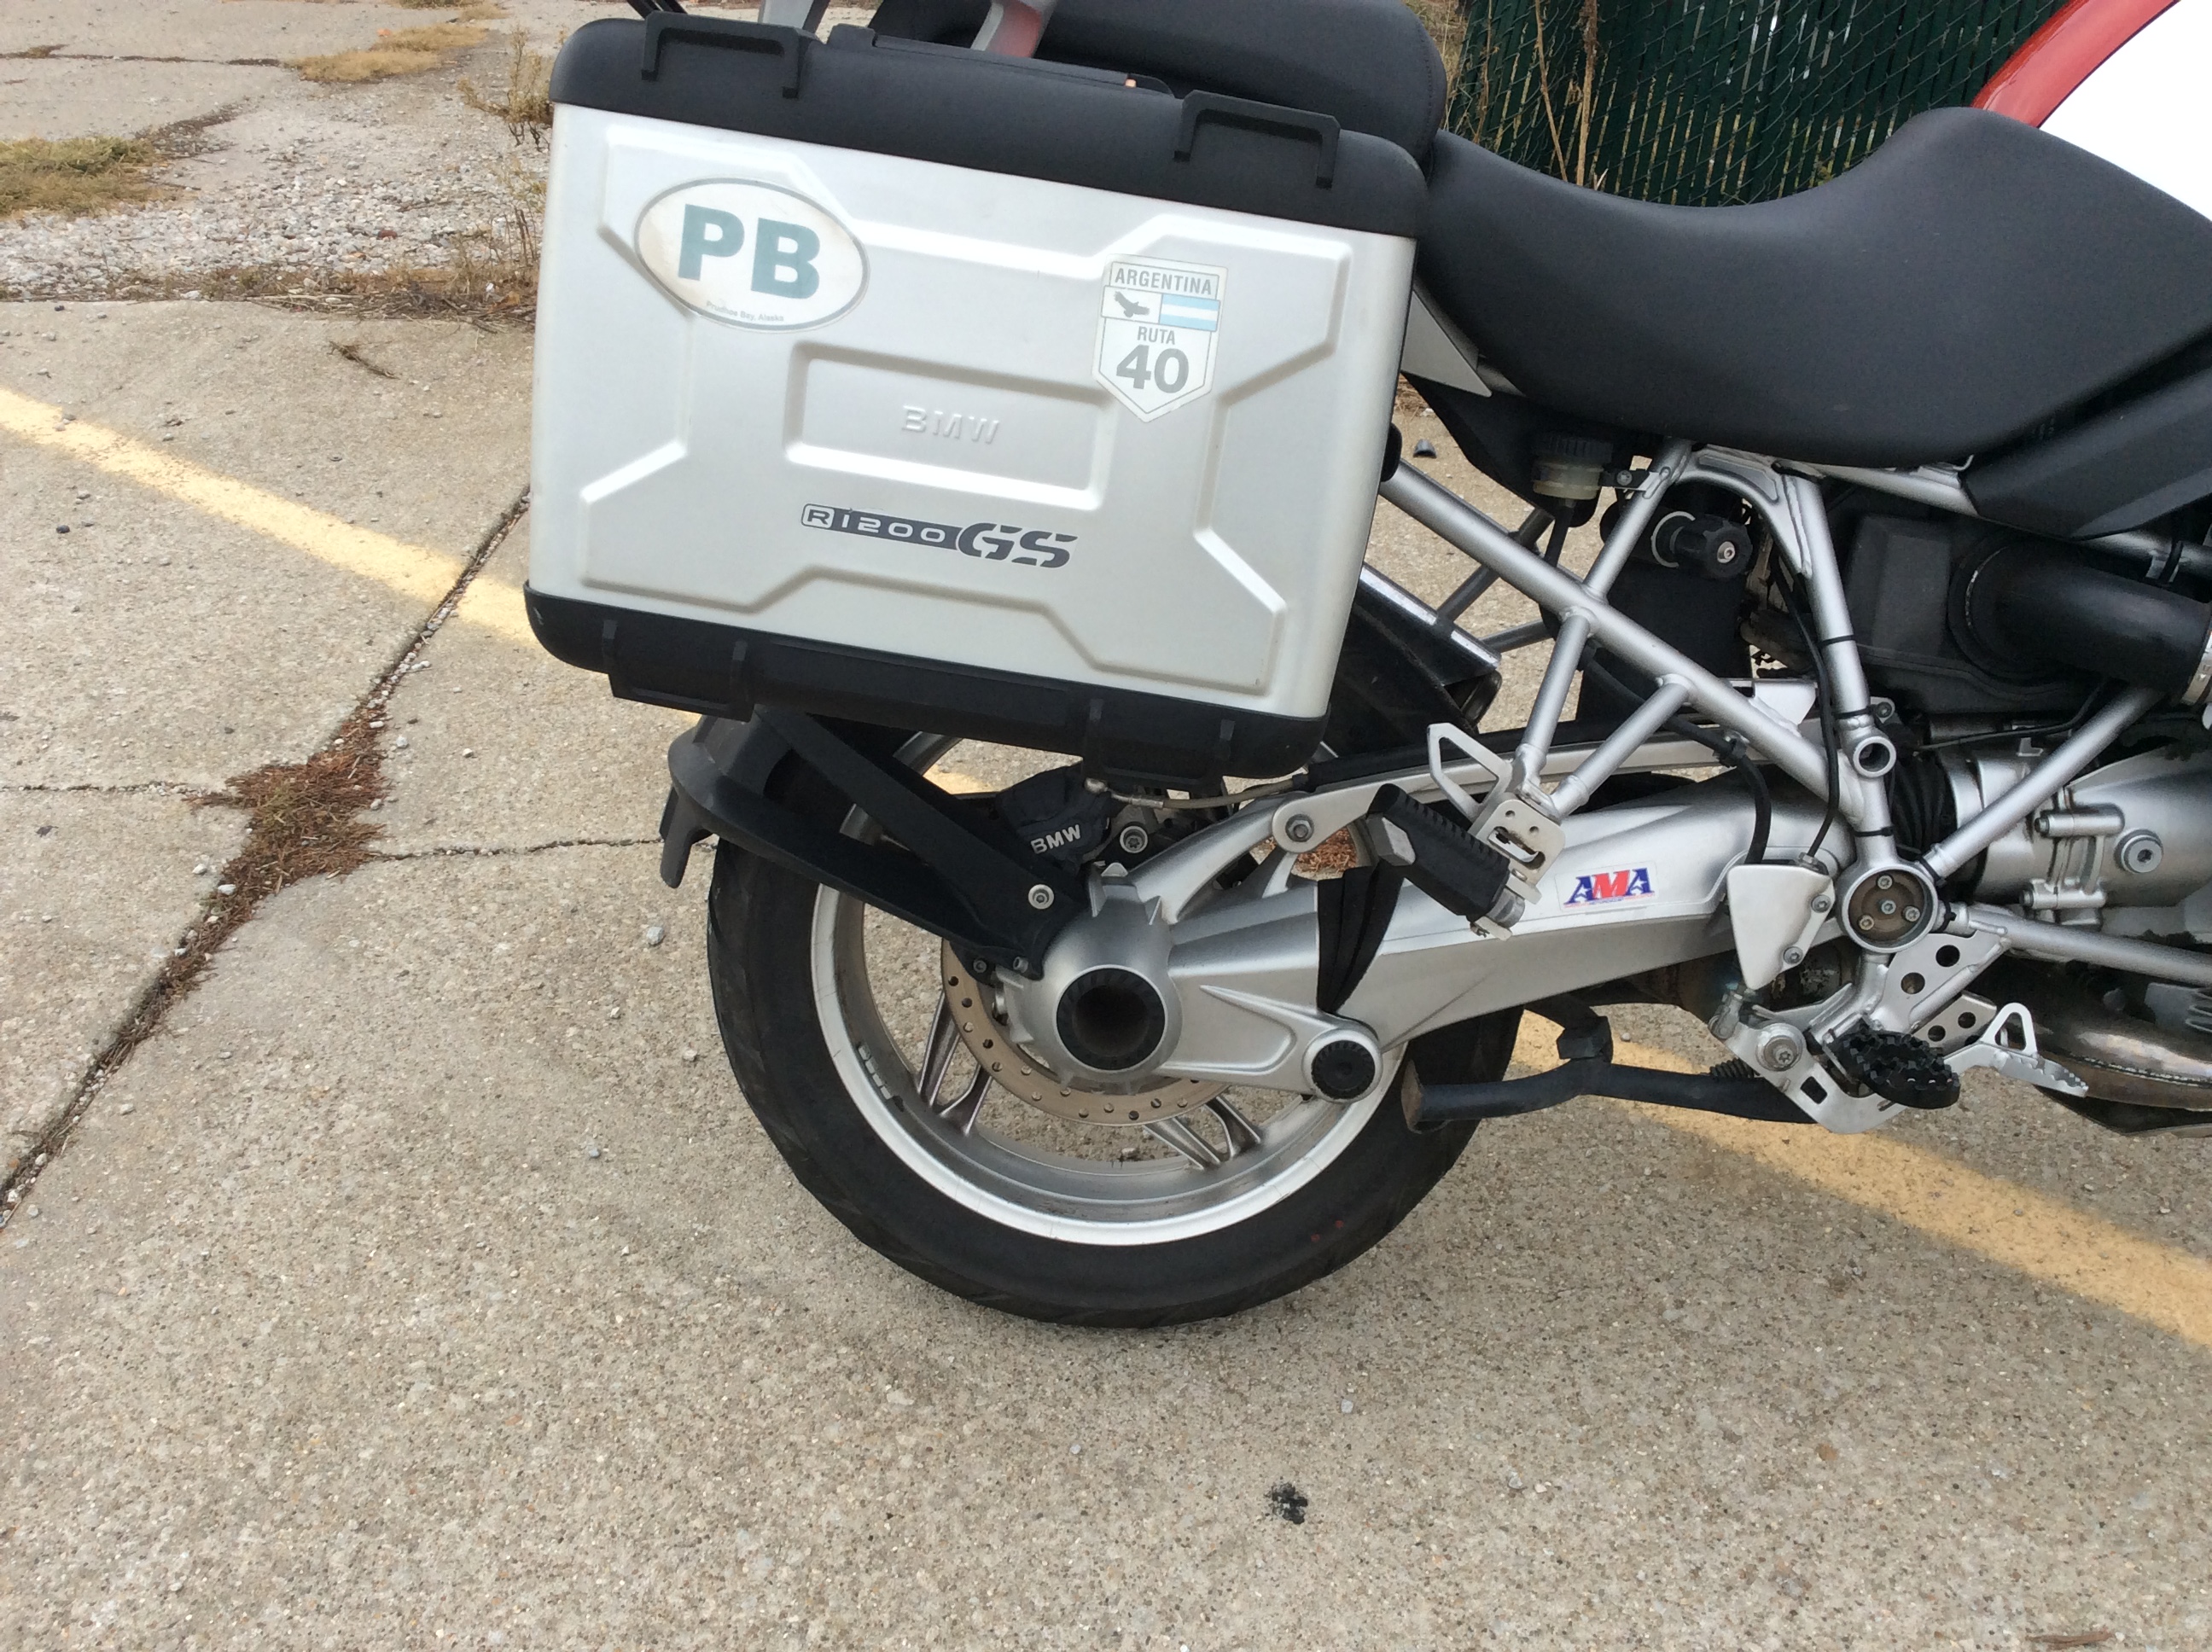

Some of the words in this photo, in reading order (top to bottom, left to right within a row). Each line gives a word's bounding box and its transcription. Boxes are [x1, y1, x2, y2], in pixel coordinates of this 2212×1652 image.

[678, 204, 820, 300] PB
[1115, 268, 1212, 295] ARGENTINA
[707, 300, 738, 317] Prudhoe
[758, 313, 784, 322] Alaska
[1137, 326, 1176, 346] RUTA
[1116, 344, 1190, 393] 40
[902, 404, 999, 444] BMW
[1031, 824, 1081, 854] BMW
[1563, 867, 1655, 905] AMA
